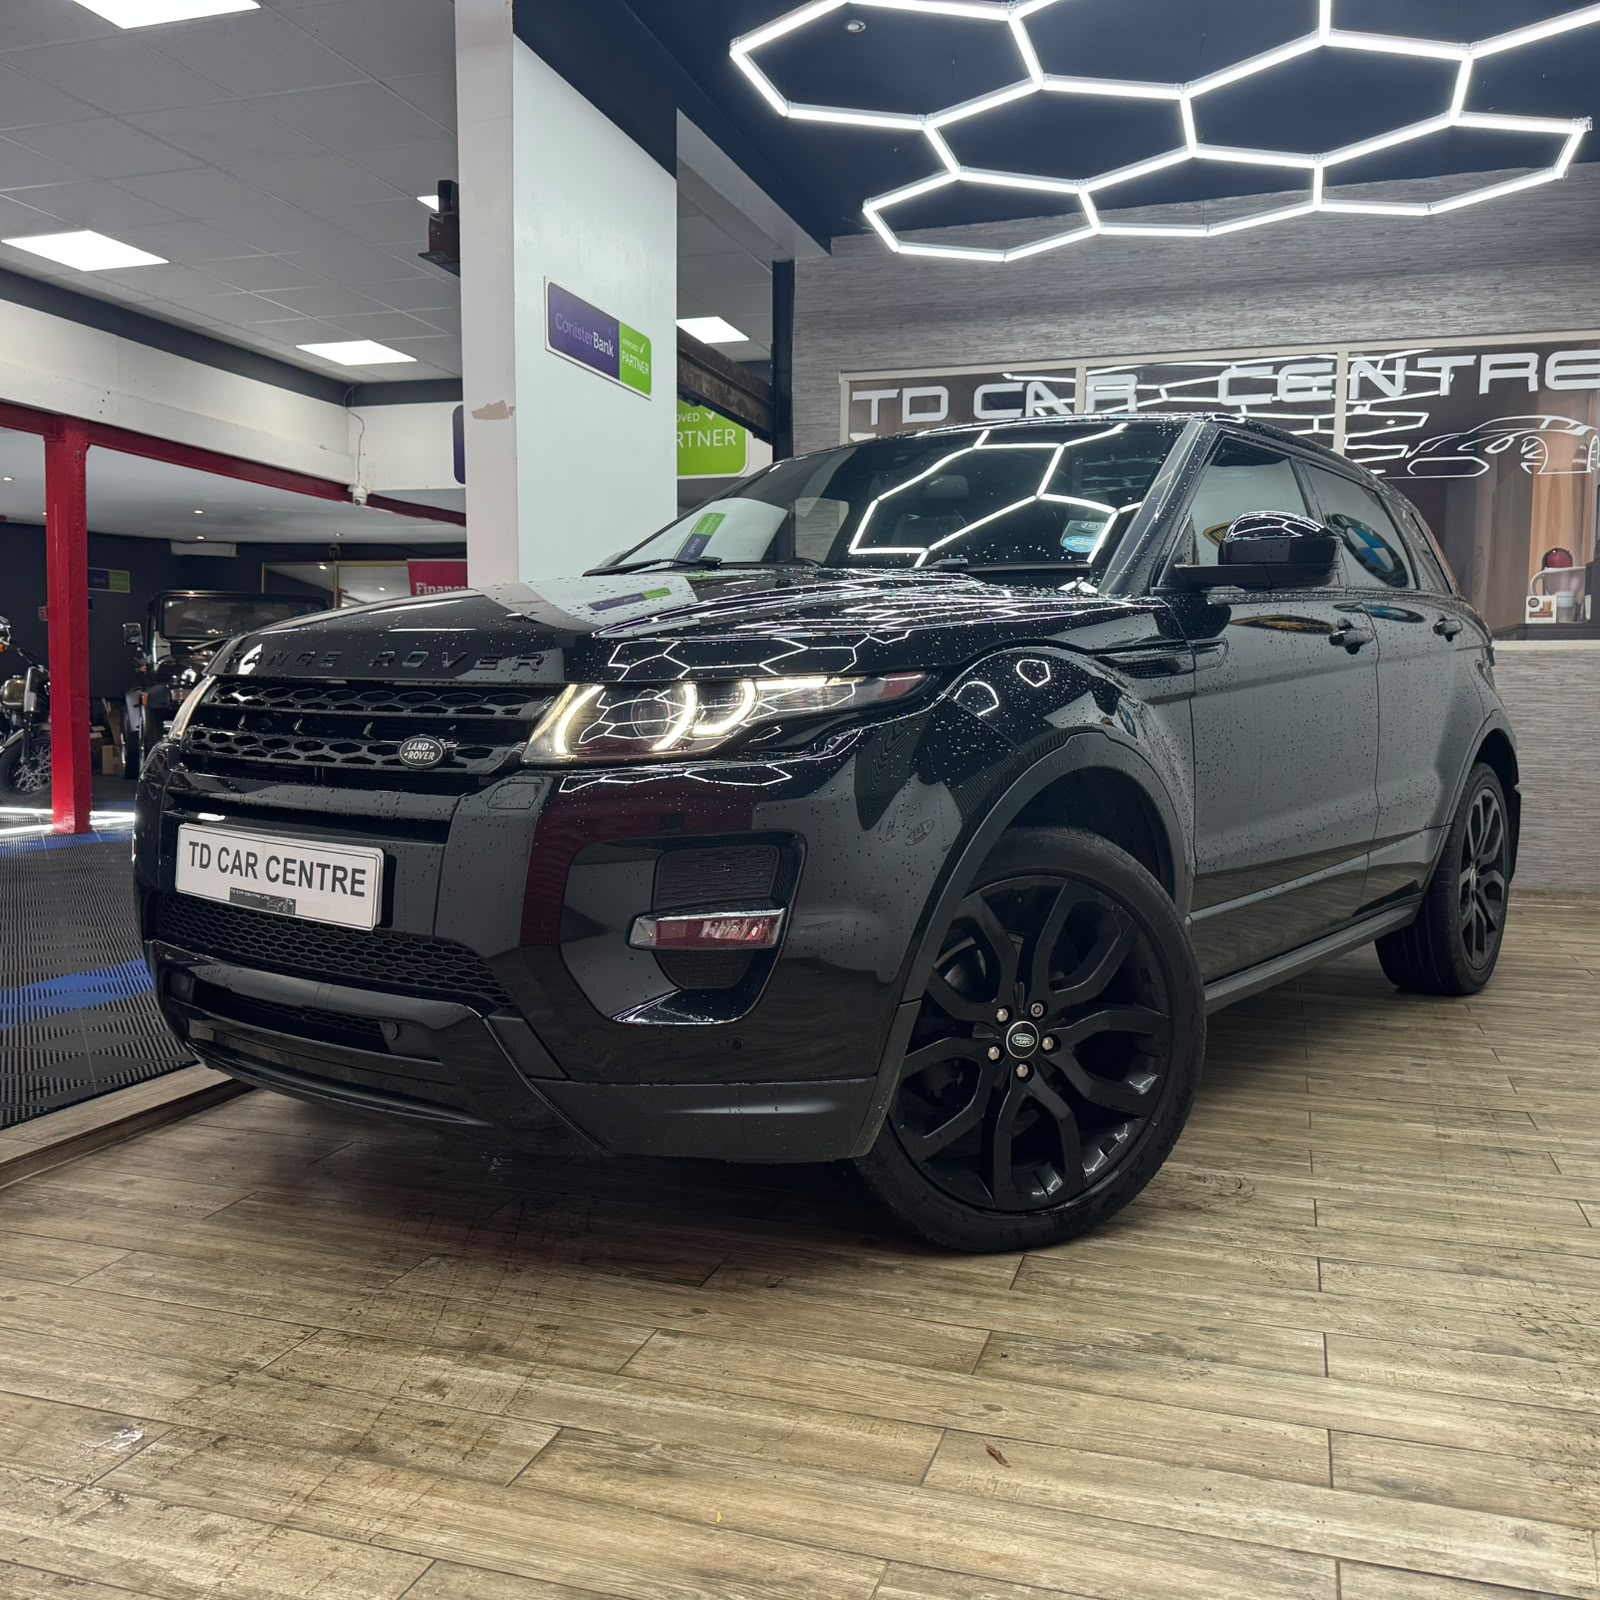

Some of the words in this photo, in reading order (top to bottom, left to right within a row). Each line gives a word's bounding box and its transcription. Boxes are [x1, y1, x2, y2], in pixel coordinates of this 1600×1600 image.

[622, 350, 649, 376] PARTNER
[852, 386, 949, 426] TD
[973, 374, 1139, 420] CAR
[1218, 349, 1600, 406] CENTRE
[677, 428, 736, 449] RTNER
[368, 650, 545, 672] ROVER
[407, 742, 430, 751] LAND
[407, 750, 436, 760] ROVER
[188, 841, 211, 869] TD
[217, 847, 258, 880] CAR
[265, 855, 367, 898] CENTRE
